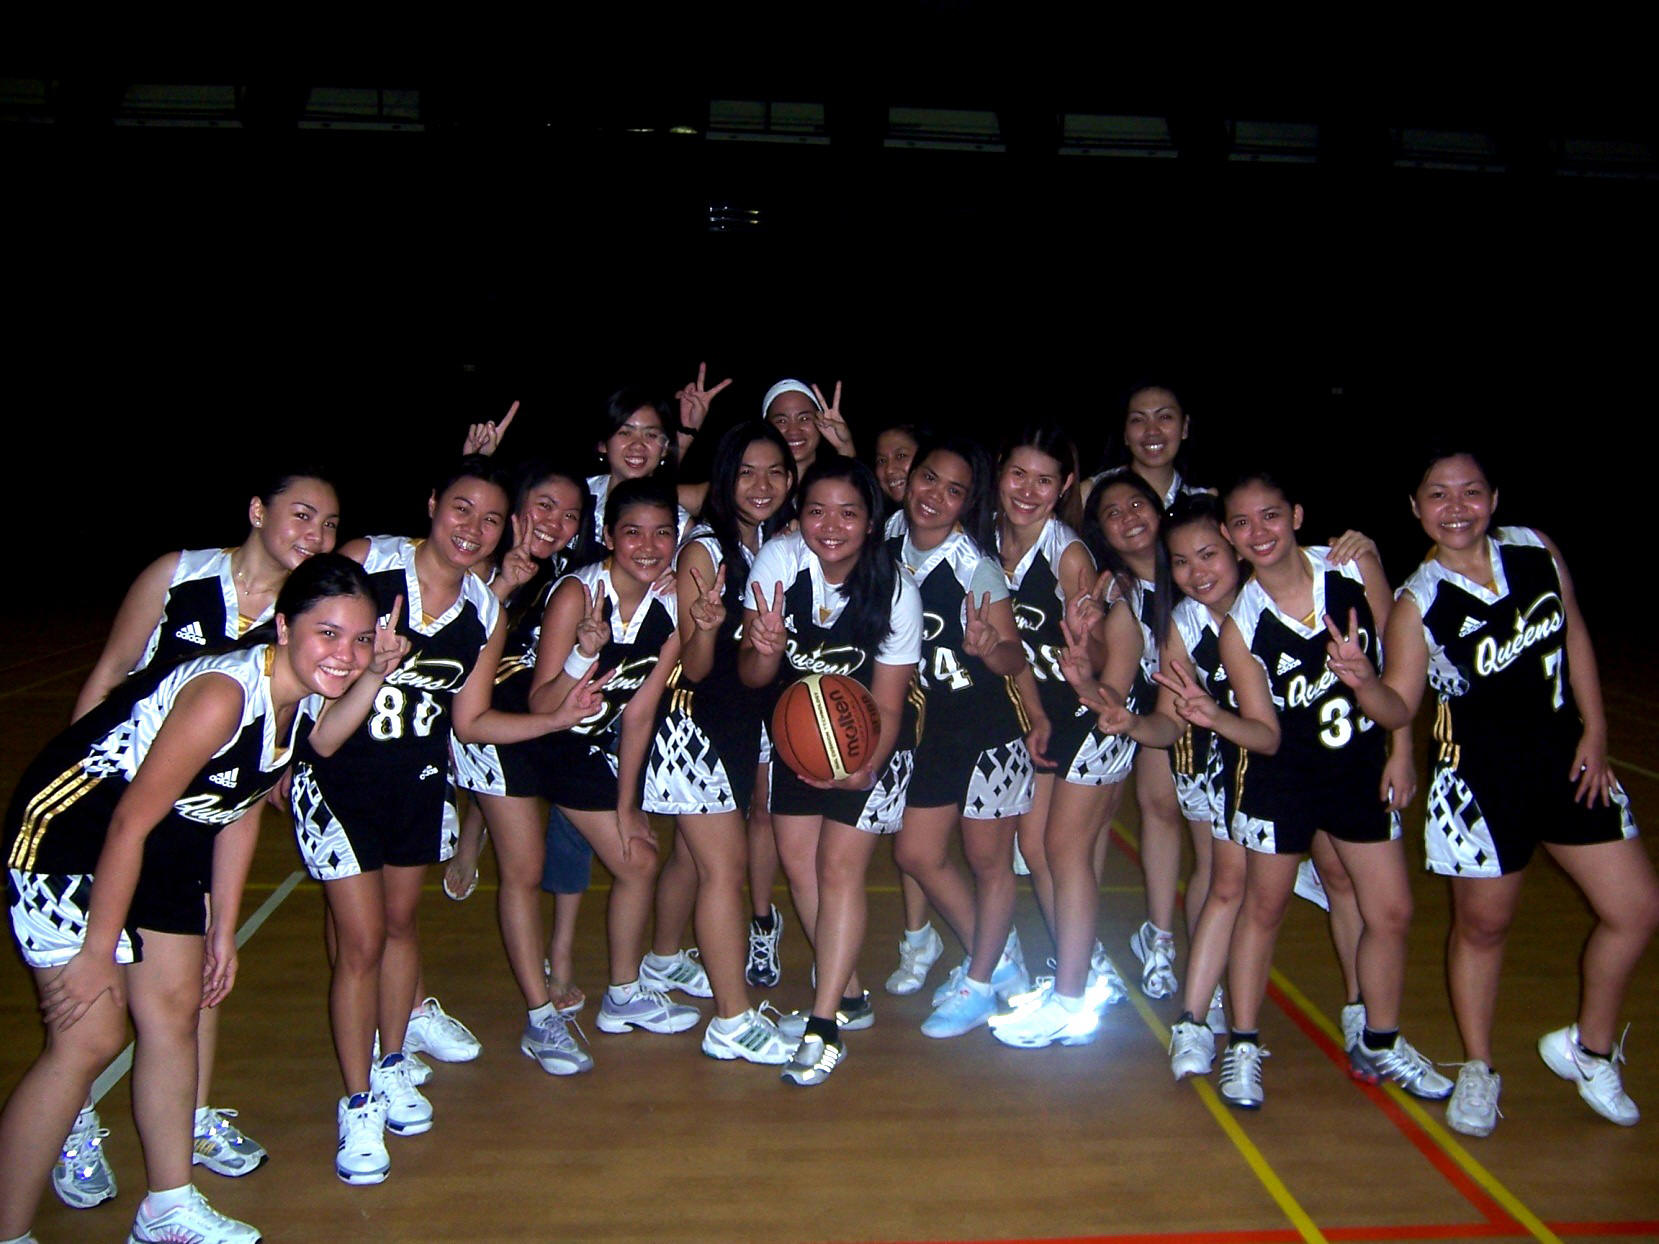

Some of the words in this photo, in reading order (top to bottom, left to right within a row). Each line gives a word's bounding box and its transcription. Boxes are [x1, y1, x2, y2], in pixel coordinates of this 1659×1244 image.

[1474, 607, 1563, 677] Queens
[1542, 646, 1563, 709] 7
[830, 690, 859, 757] molten
